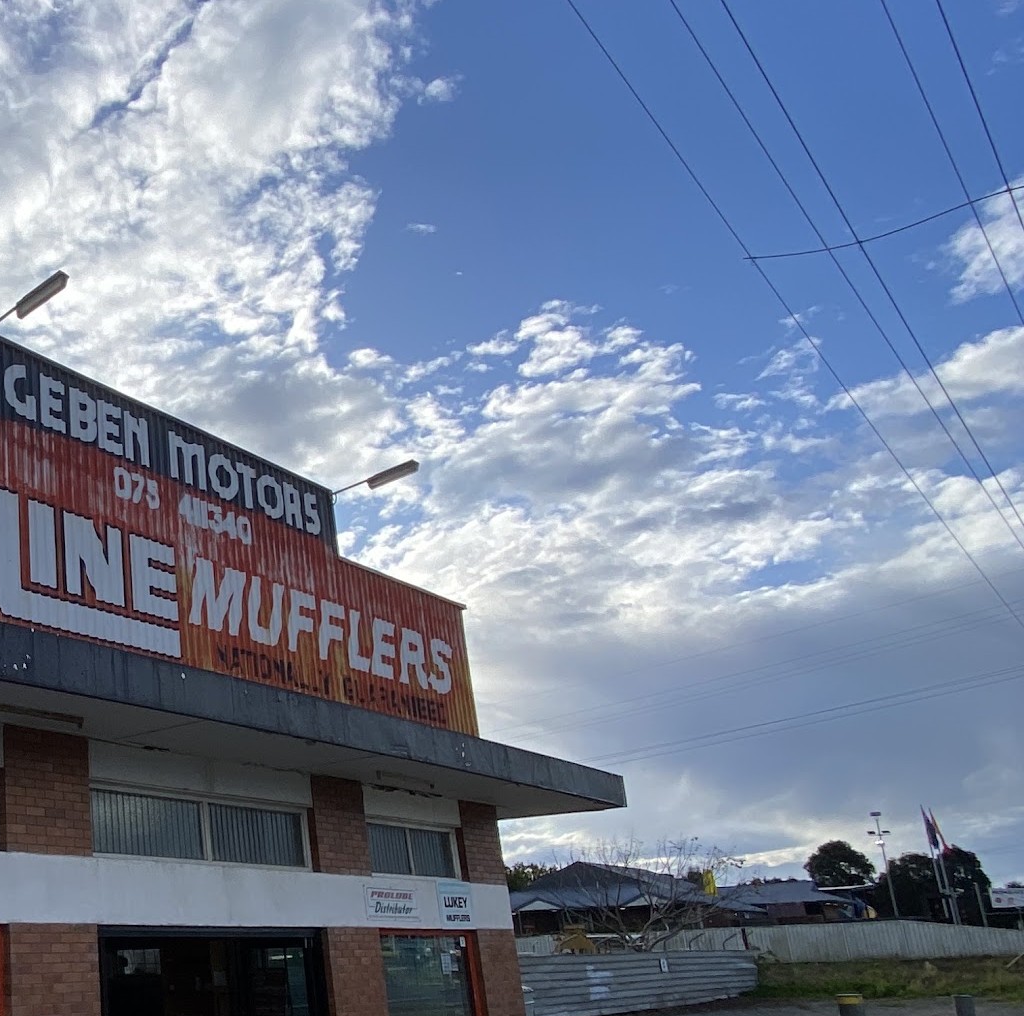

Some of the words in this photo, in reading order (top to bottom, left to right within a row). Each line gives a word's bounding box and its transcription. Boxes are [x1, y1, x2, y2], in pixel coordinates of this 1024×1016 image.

[3, 364, 150, 468] GEBEN
[169, 430, 322, 536] MOTORS
[114, 466, 160, 510] 075
[188, 556, 453, 695] MUFFLERS
[375, 901, 413, 915] Distributor
[443, 896, 468, 909] LUKEY
[446, 914, 471, 922] MUFFLERS
